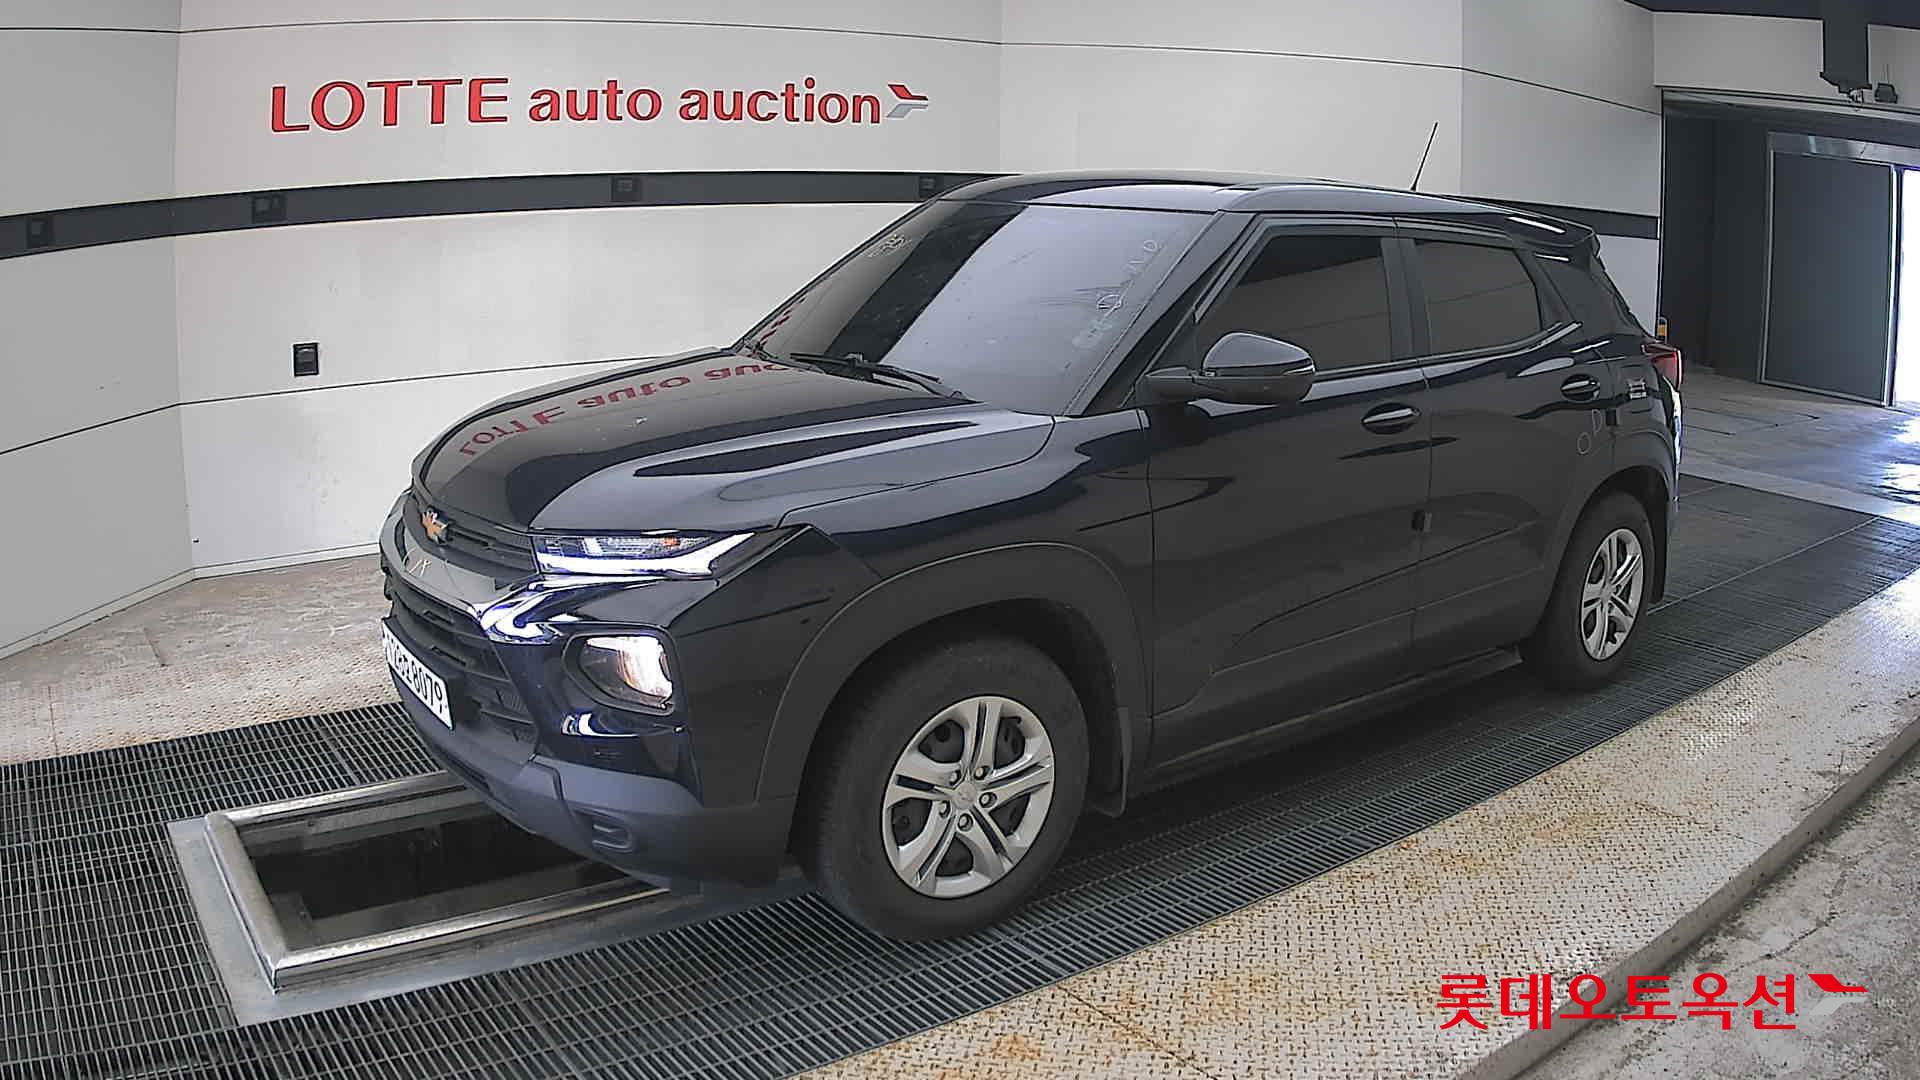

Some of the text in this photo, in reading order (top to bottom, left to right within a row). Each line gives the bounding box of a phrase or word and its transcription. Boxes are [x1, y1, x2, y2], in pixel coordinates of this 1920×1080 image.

[271, 77, 881, 133] LOTTE auto auction
